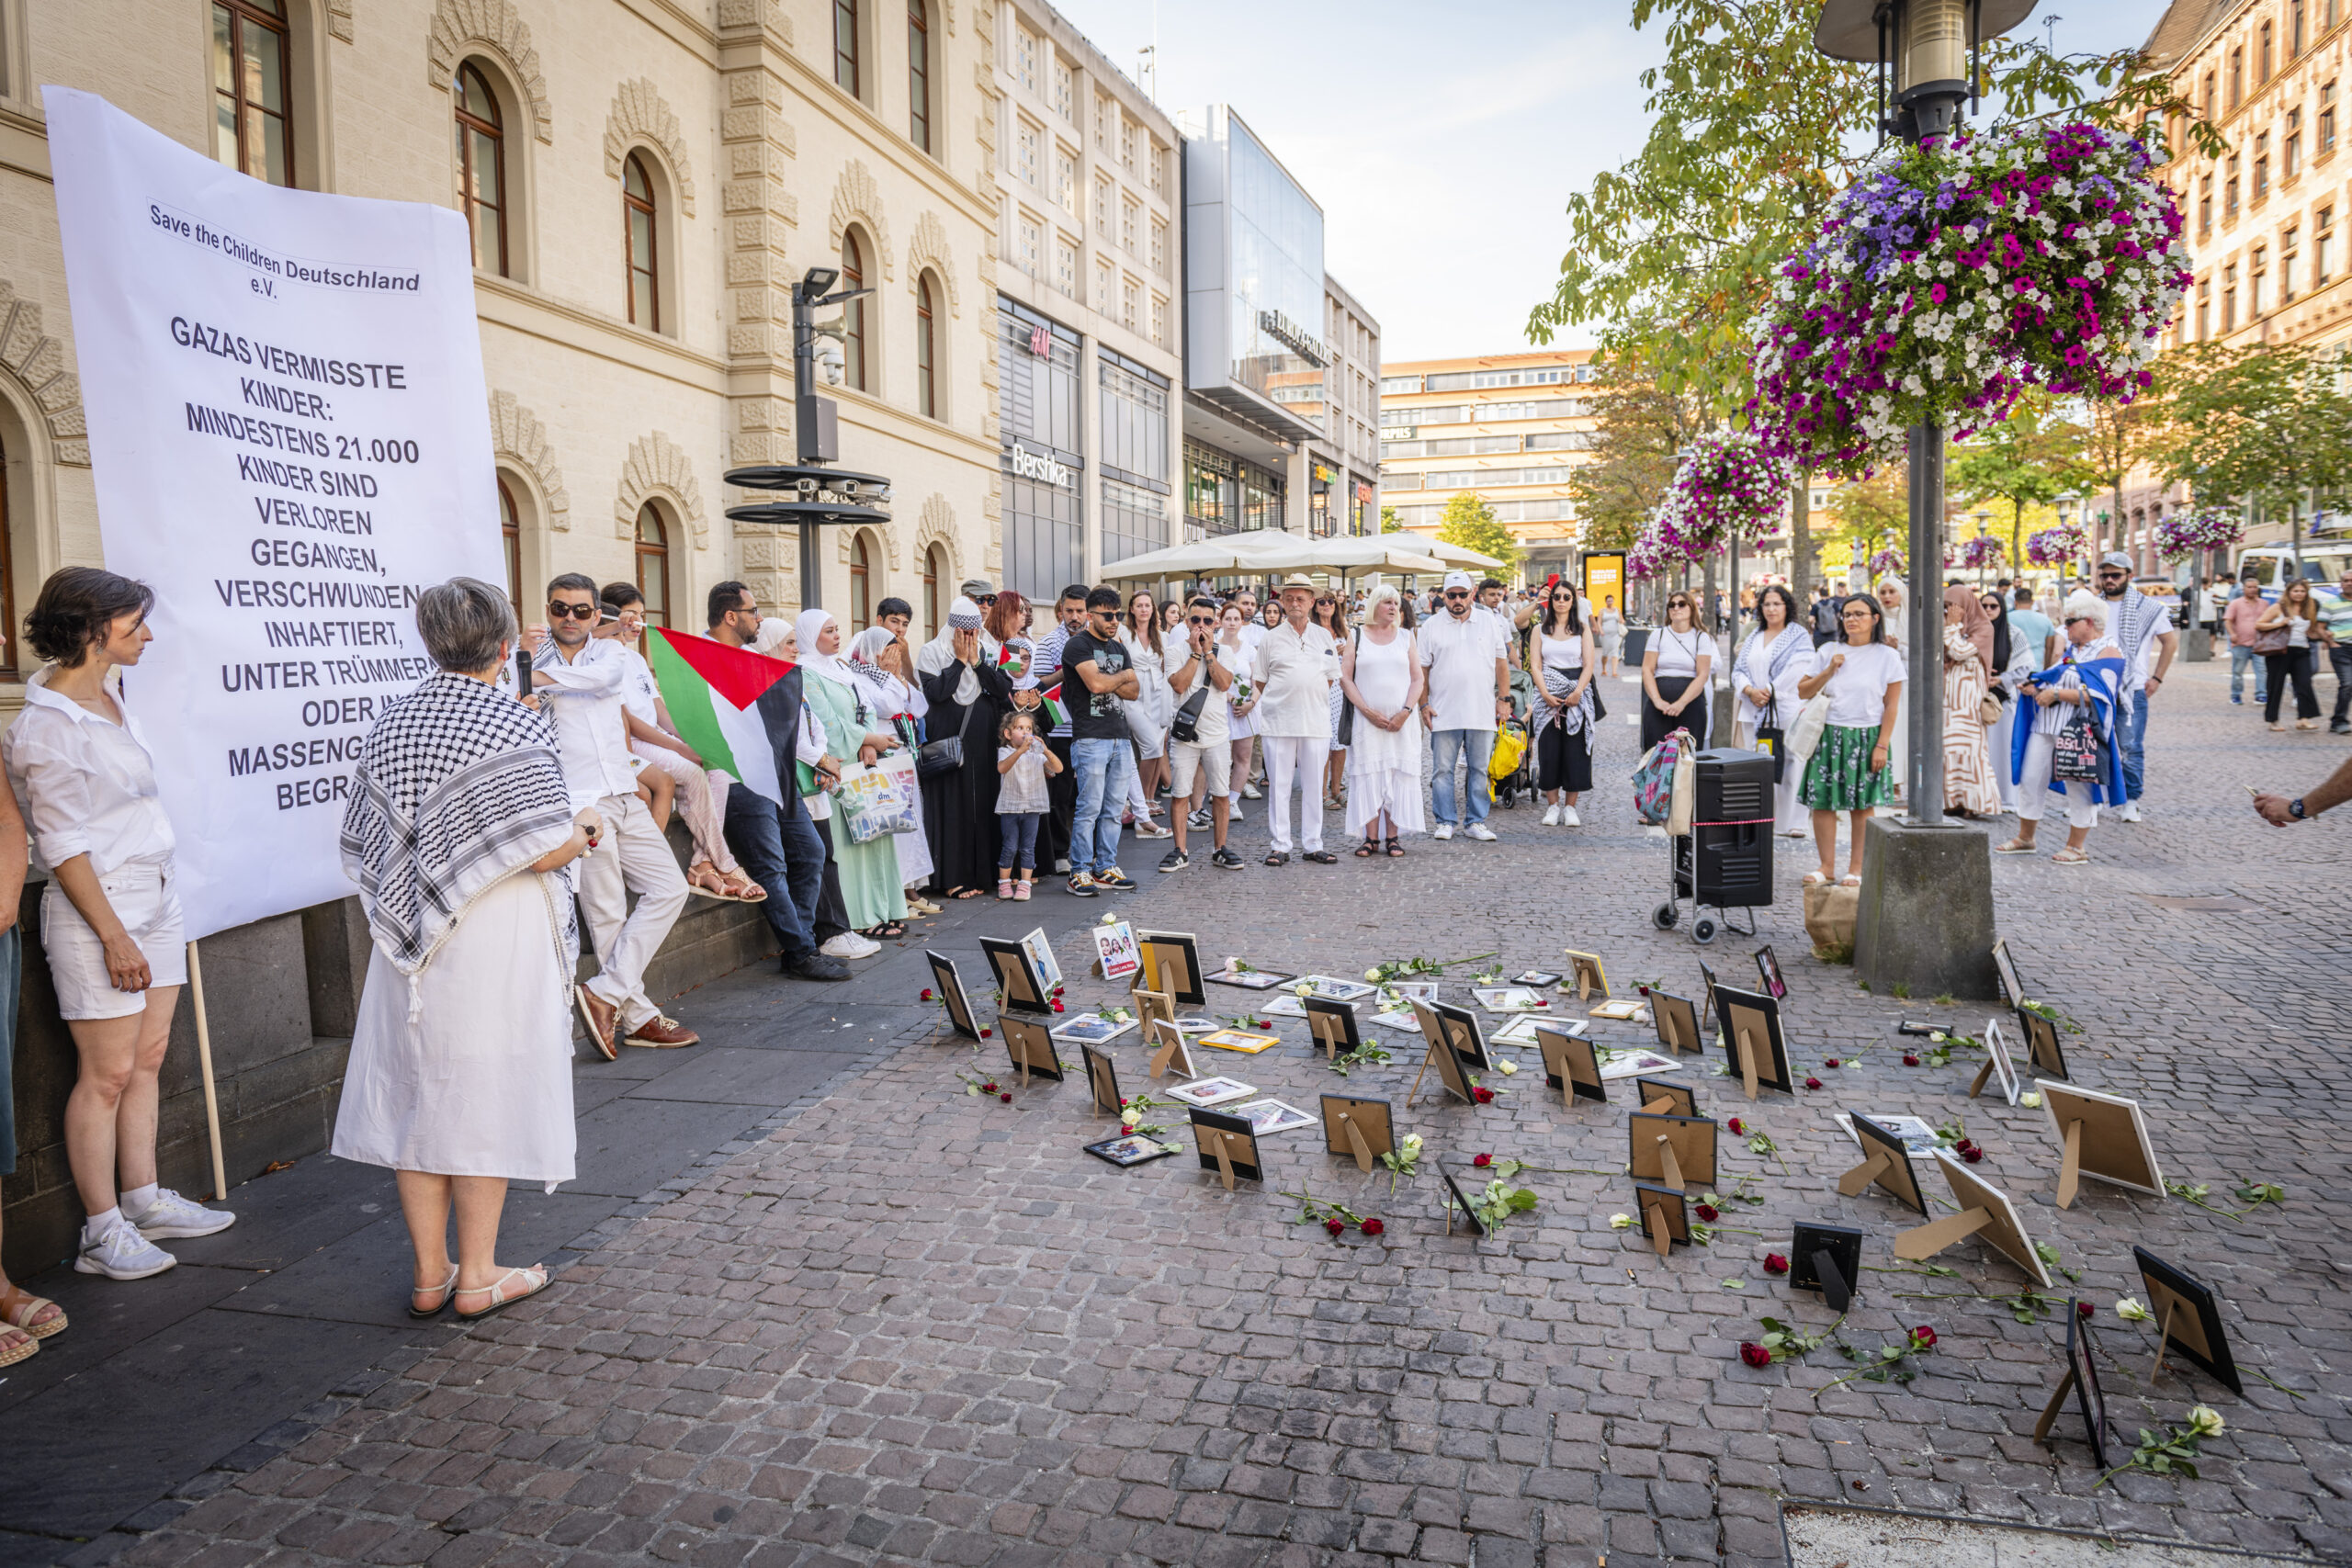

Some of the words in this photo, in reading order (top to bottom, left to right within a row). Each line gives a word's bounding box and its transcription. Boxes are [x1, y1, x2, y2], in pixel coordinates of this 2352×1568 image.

[150, 204, 191, 237] Save
[195, 223, 220, 249] the
[222, 235, 281, 275] Children
[285, 260, 420, 291] Deutschland
[251, 277, 277, 299] e.V.
[170, 316, 252, 365] GAZAS
[254, 341, 407, 389] VERMISSTE
[240, 376, 334, 422] KINDER:
[185, 401, 330, 457] MINDESTENS
[334, 434, 420, 464] 21.000
[236, 453, 318, 493] KINDER
[319, 469, 379, 499] SIND
[1012, 443, 1067, 487] Bershka
[254, 496, 372, 535] VERLOREN
[250, 538, 387, 578] GEGANGEN,
[214, 579, 420, 609] VERSCHWUNDEN
[264, 621, 404, 649] INHAFTIERT,
[221, 660, 320, 693] UNTER
[301, 696, 376, 728] ODER
[228, 735, 363, 777] MASSENG
[2055, 737, 2098, 751] BERLIN
[277, 774, 349, 811] BEGR
[877, 791, 890, 800] dm
